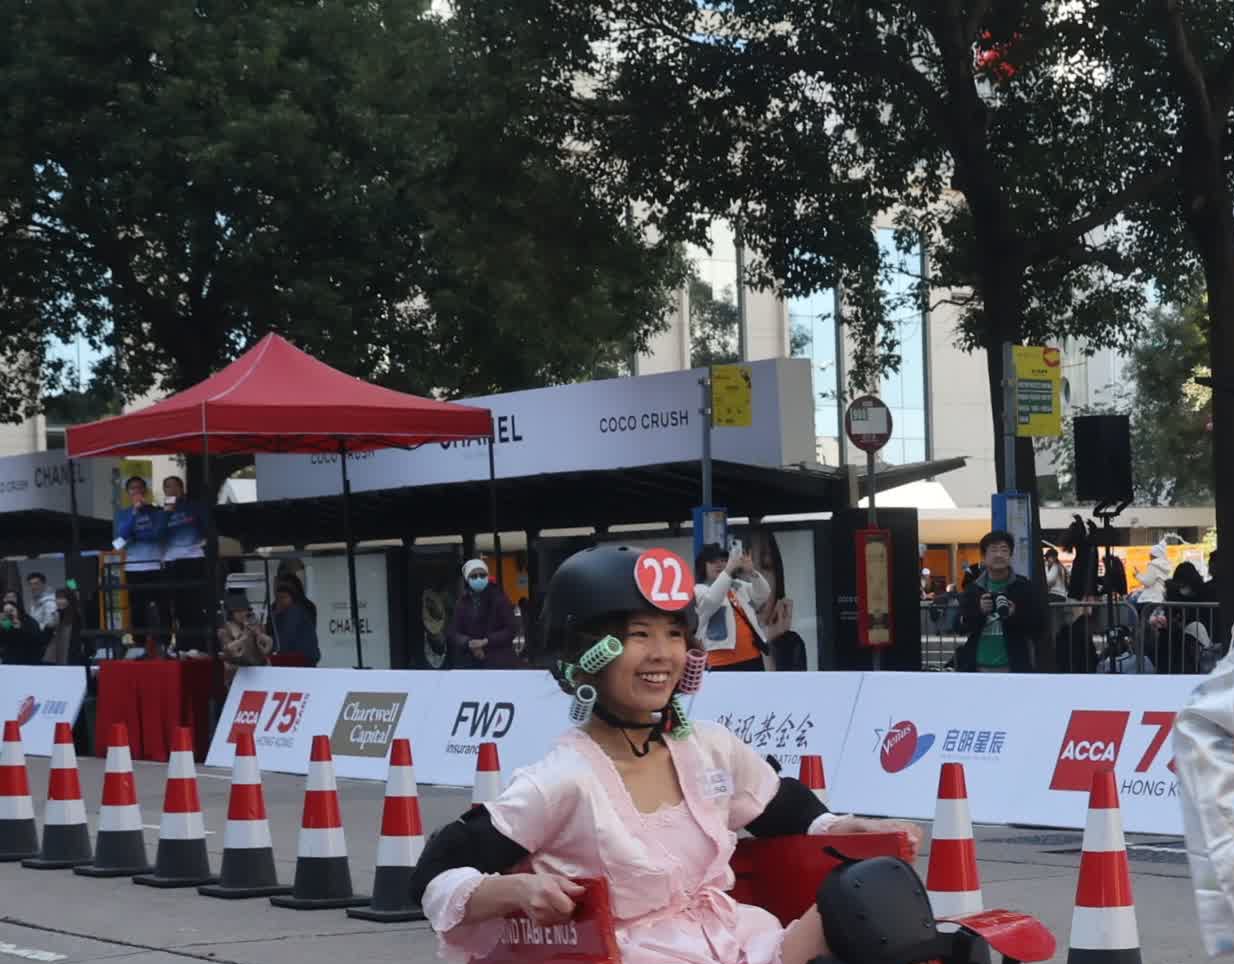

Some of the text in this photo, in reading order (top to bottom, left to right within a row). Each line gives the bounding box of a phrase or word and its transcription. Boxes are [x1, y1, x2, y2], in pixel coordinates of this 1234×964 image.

[599, 408, 689, 433] COCO CRUSH
[640, 557, 691, 603] 22
[329, 617, 374, 635] CHAEL
[234, 710, 259, 723] ACCA
[264, 692, 303, 734] 75
[343, 702, 399, 723] Chartwell
[451, 701, 515, 739] FWD
[350, 725, 391, 749] Capital
[1060, 711, 1182, 775] ACCA 7
[446, 744, 480, 755] insuran
[1120, 780, 1164, 796] HONG
